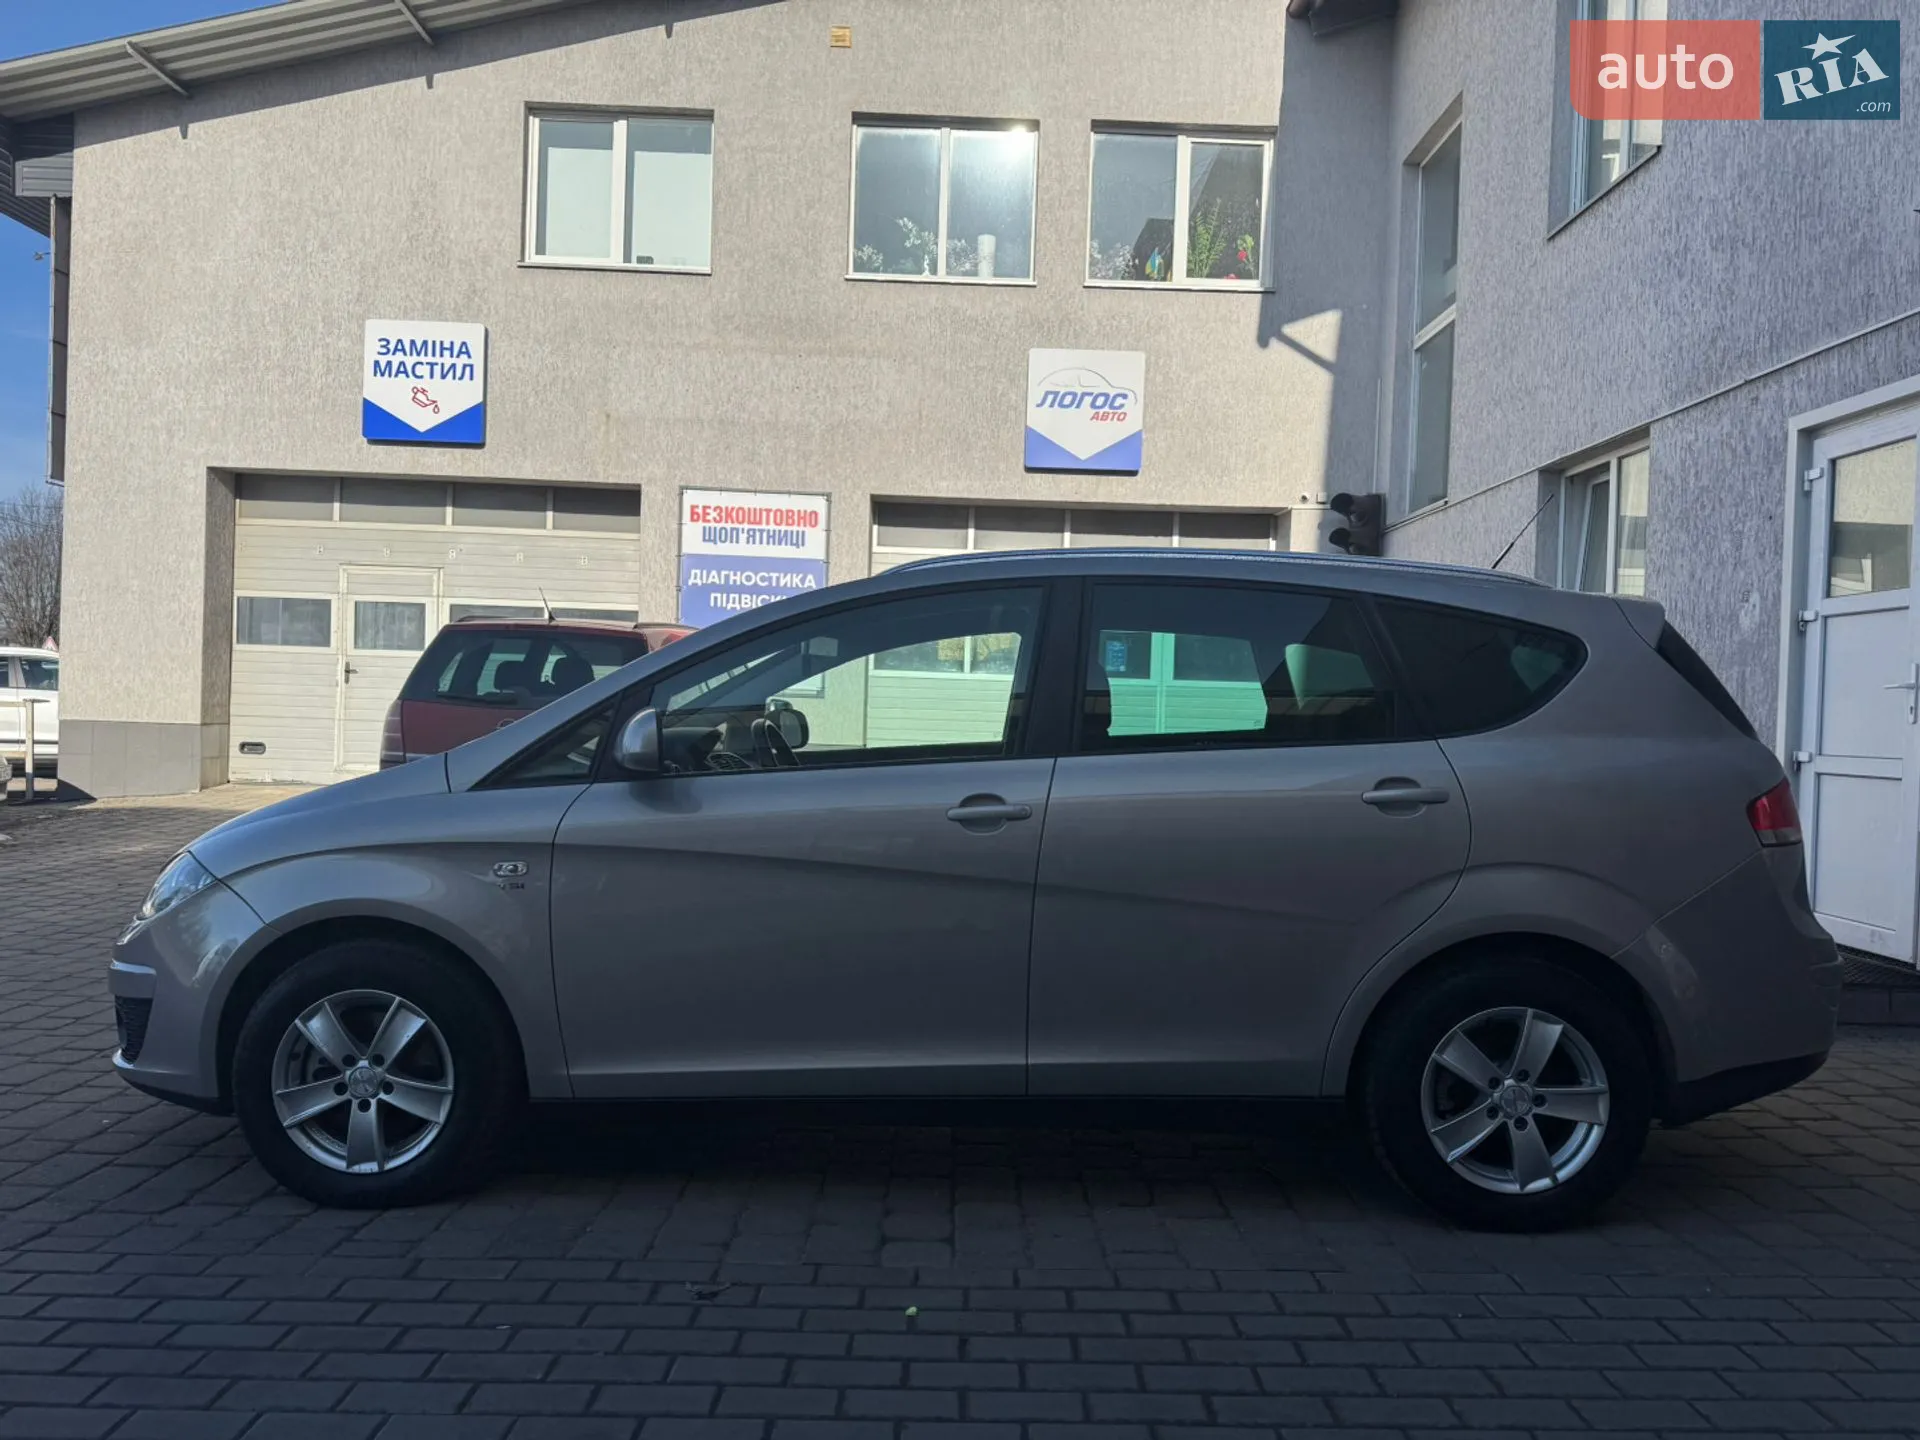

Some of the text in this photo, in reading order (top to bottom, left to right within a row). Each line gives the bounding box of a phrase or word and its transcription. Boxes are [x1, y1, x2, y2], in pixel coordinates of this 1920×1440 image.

[376, 337, 472, 359] ЗАМІНА
[373, 359, 474, 381] МАСТИЛ
[1035, 390, 1128, 410] ЛОГОС
[1090, 411, 1127, 422] АВТО
[689, 504, 819, 528] БЕЗКОШТОВНО
[702, 525, 806, 549] ЩОП'ЯТНИЦІ
[688, 569, 816, 588] ДІАГНОСТИКА
